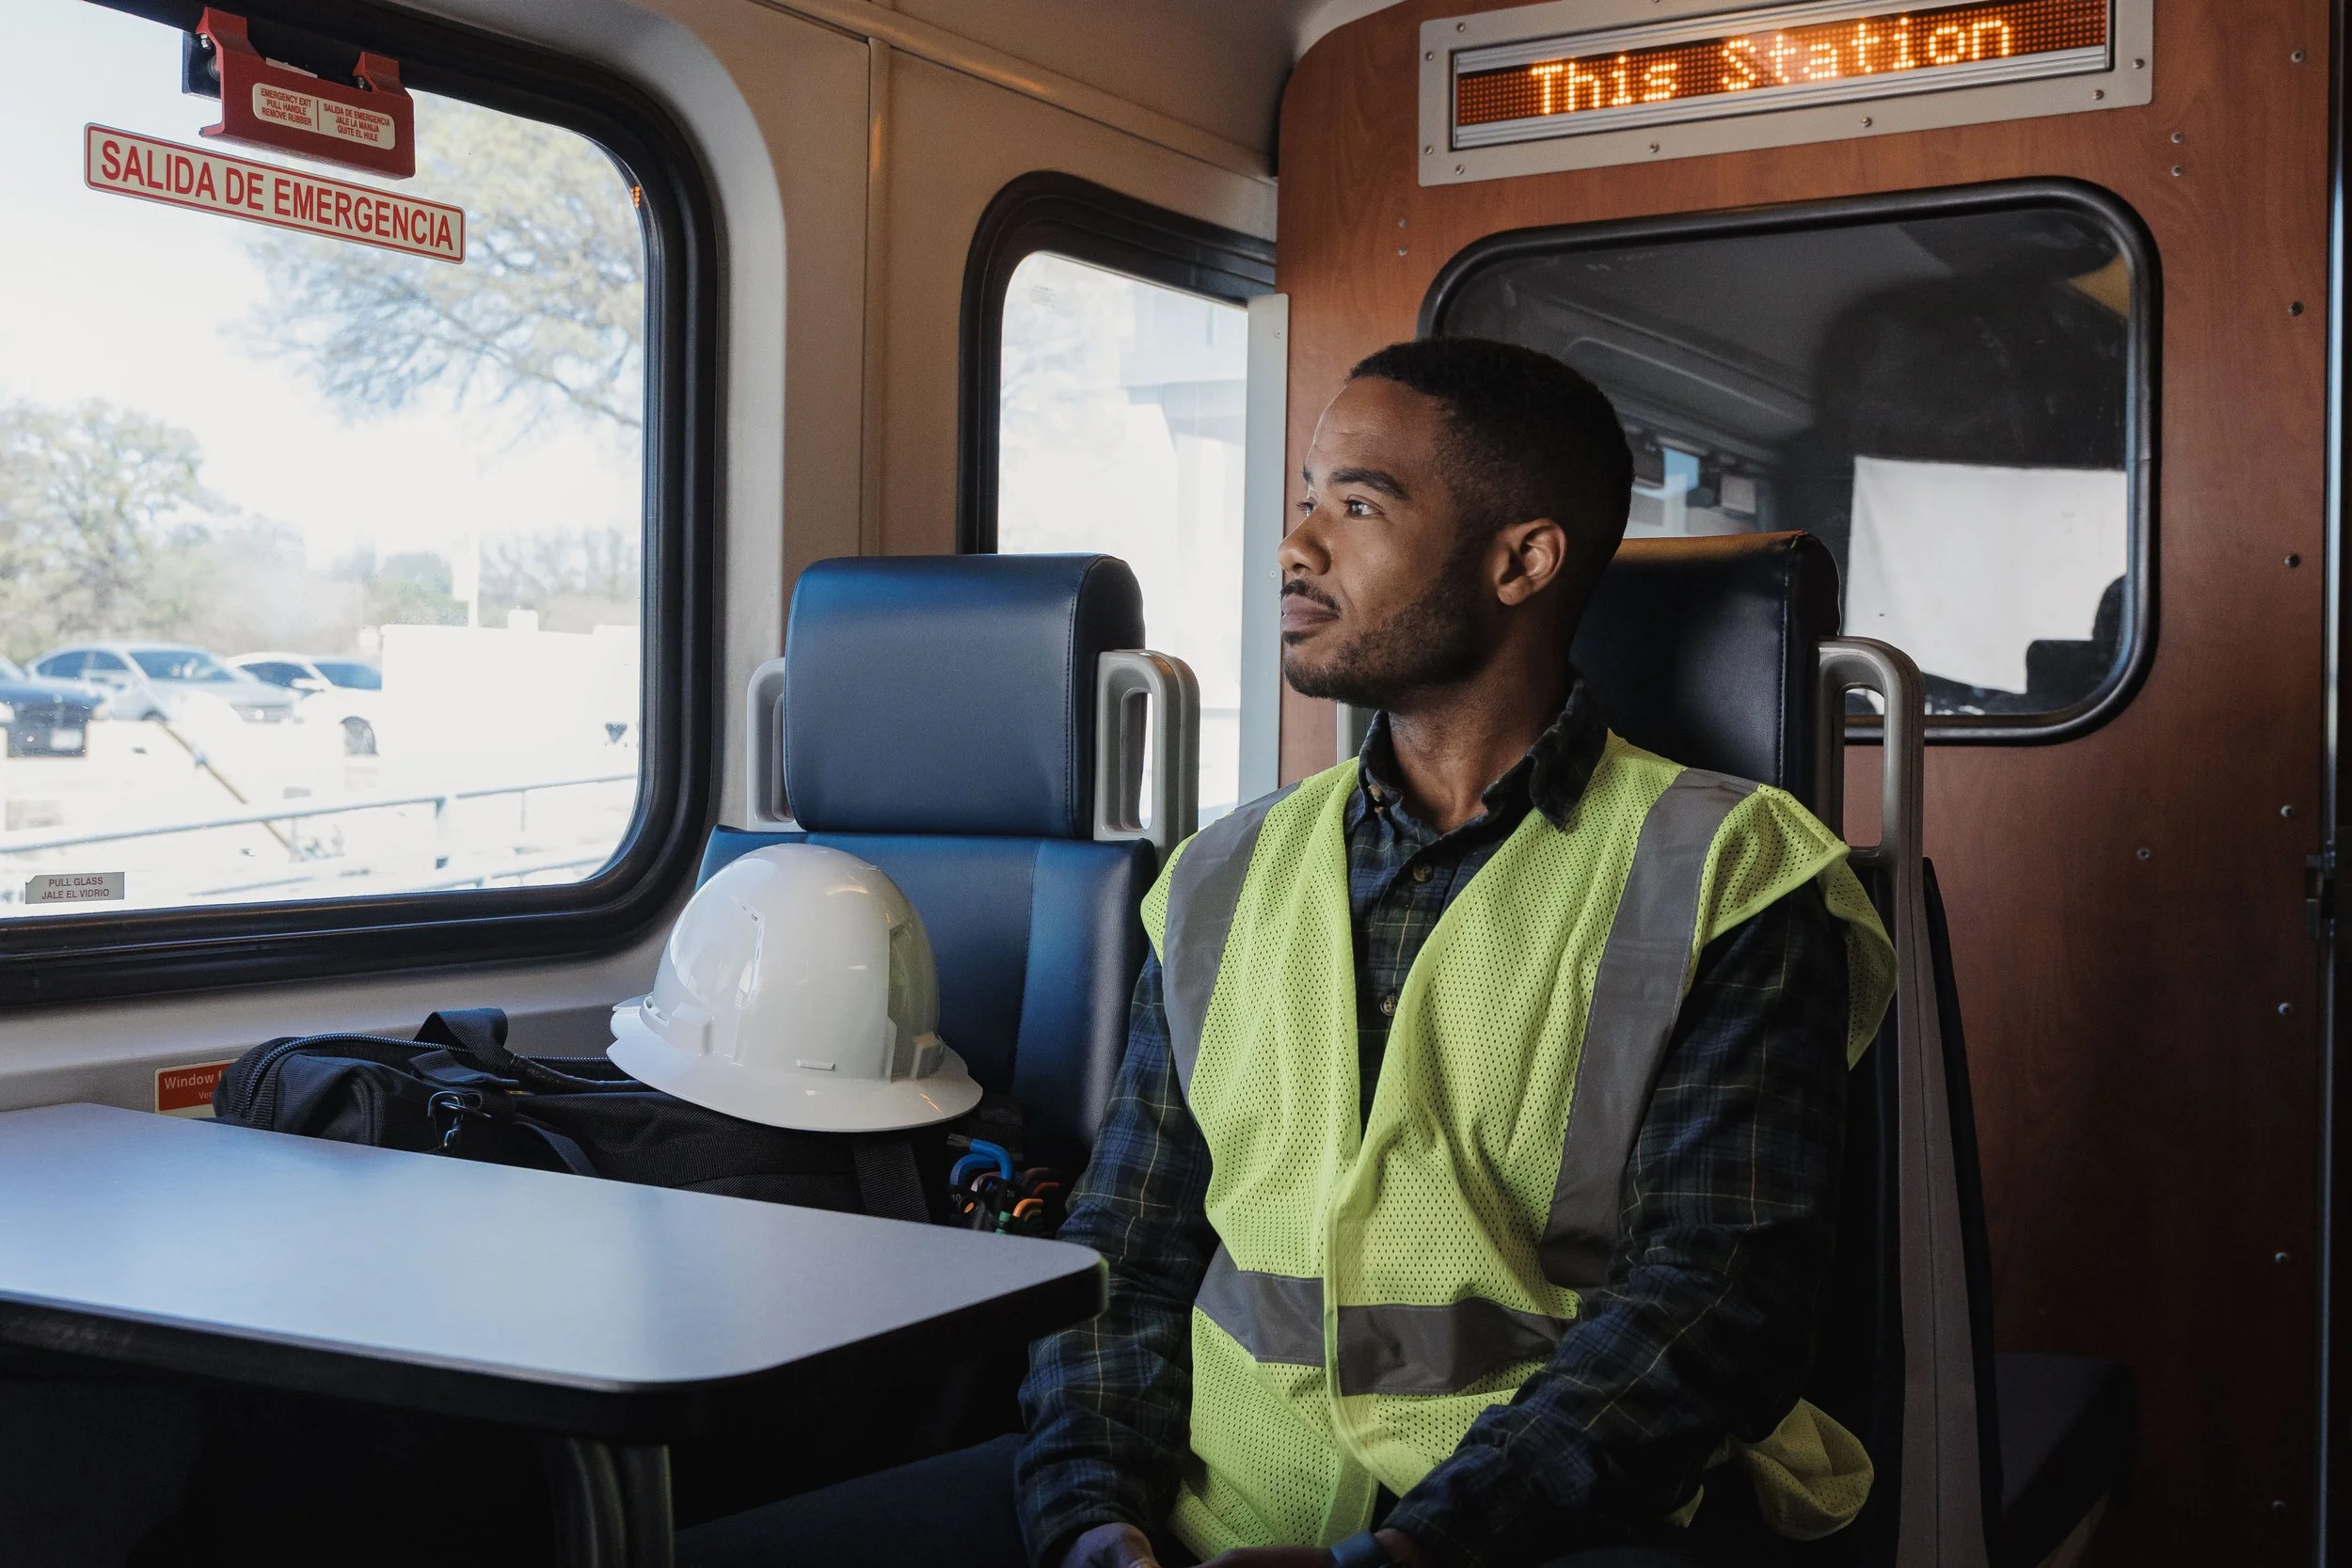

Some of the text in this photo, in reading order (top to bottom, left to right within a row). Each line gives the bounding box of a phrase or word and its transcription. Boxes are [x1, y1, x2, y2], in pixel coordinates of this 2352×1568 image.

[1531, 17, 2010, 116] This Station
[261, 88, 311, 107] EMERGENCY EXIT
[266, 99, 307, 115] PULL HANDLE
[324, 103, 390, 127] SALIDA DE EMERGENCIA
[262, 107, 311, 126] REMOVE RUBBER
[335, 116, 379, 133] JALE LA MANIJA
[337, 124, 378, 141] QUITE EL HULE
[101, 139, 454, 251] SALIDA DE EMERGENCIA
[48, 877, 103, 887] PULL GLASS
[41, 888, 110, 900] JALE EL VIDRIO
[164, 1073, 215, 1090] Window
